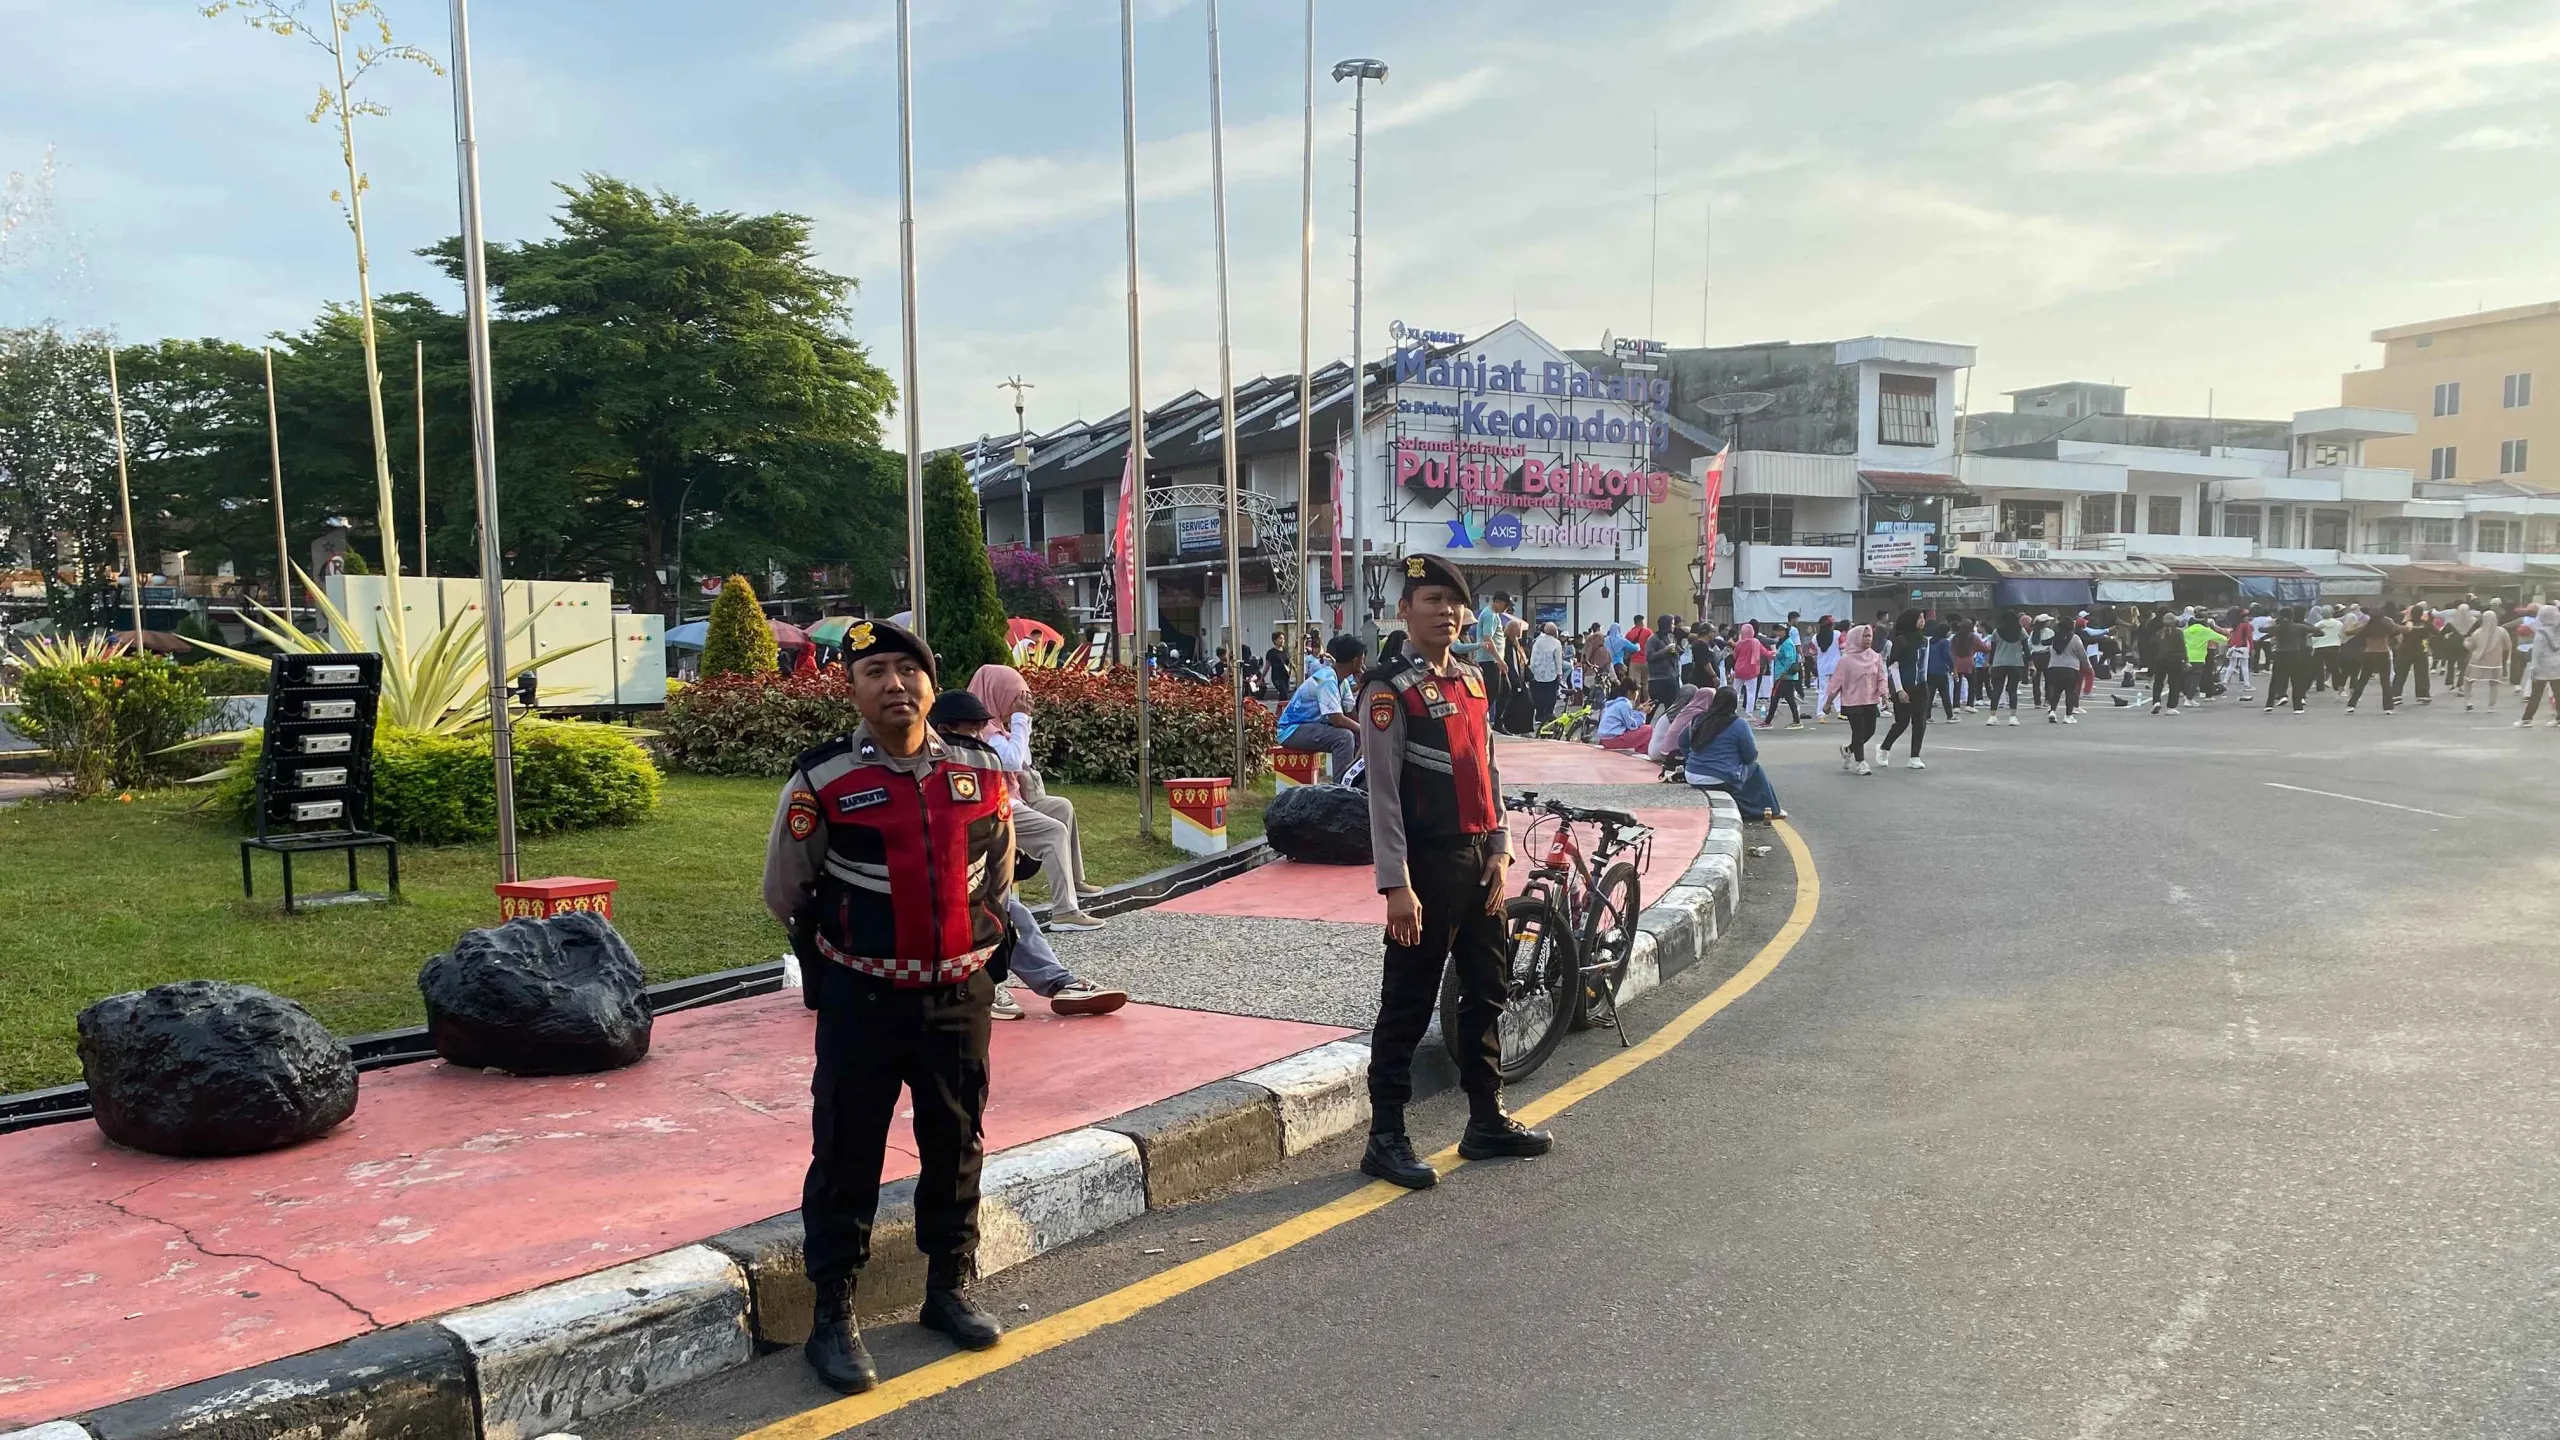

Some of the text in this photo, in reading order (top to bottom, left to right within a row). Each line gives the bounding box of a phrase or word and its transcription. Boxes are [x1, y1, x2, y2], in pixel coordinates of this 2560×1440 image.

[1396, 349, 1670, 411] Manjat Batang
[1414, 401, 1459, 417] Pohon
[1463, 400, 1669, 451] Kedondong
[1398, 435, 1455, 453] Selamat
[1396, 450, 1670, 504] Pulau Belitong
[1181, 520, 1209, 533] SERVICE
[1210, 518, 1220, 529] HP
[1490, 526, 1517, 538] AXIS
[1975, 542, 2002, 555] MEKAR
[1796, 561, 1829, 573] PAKISTAN
